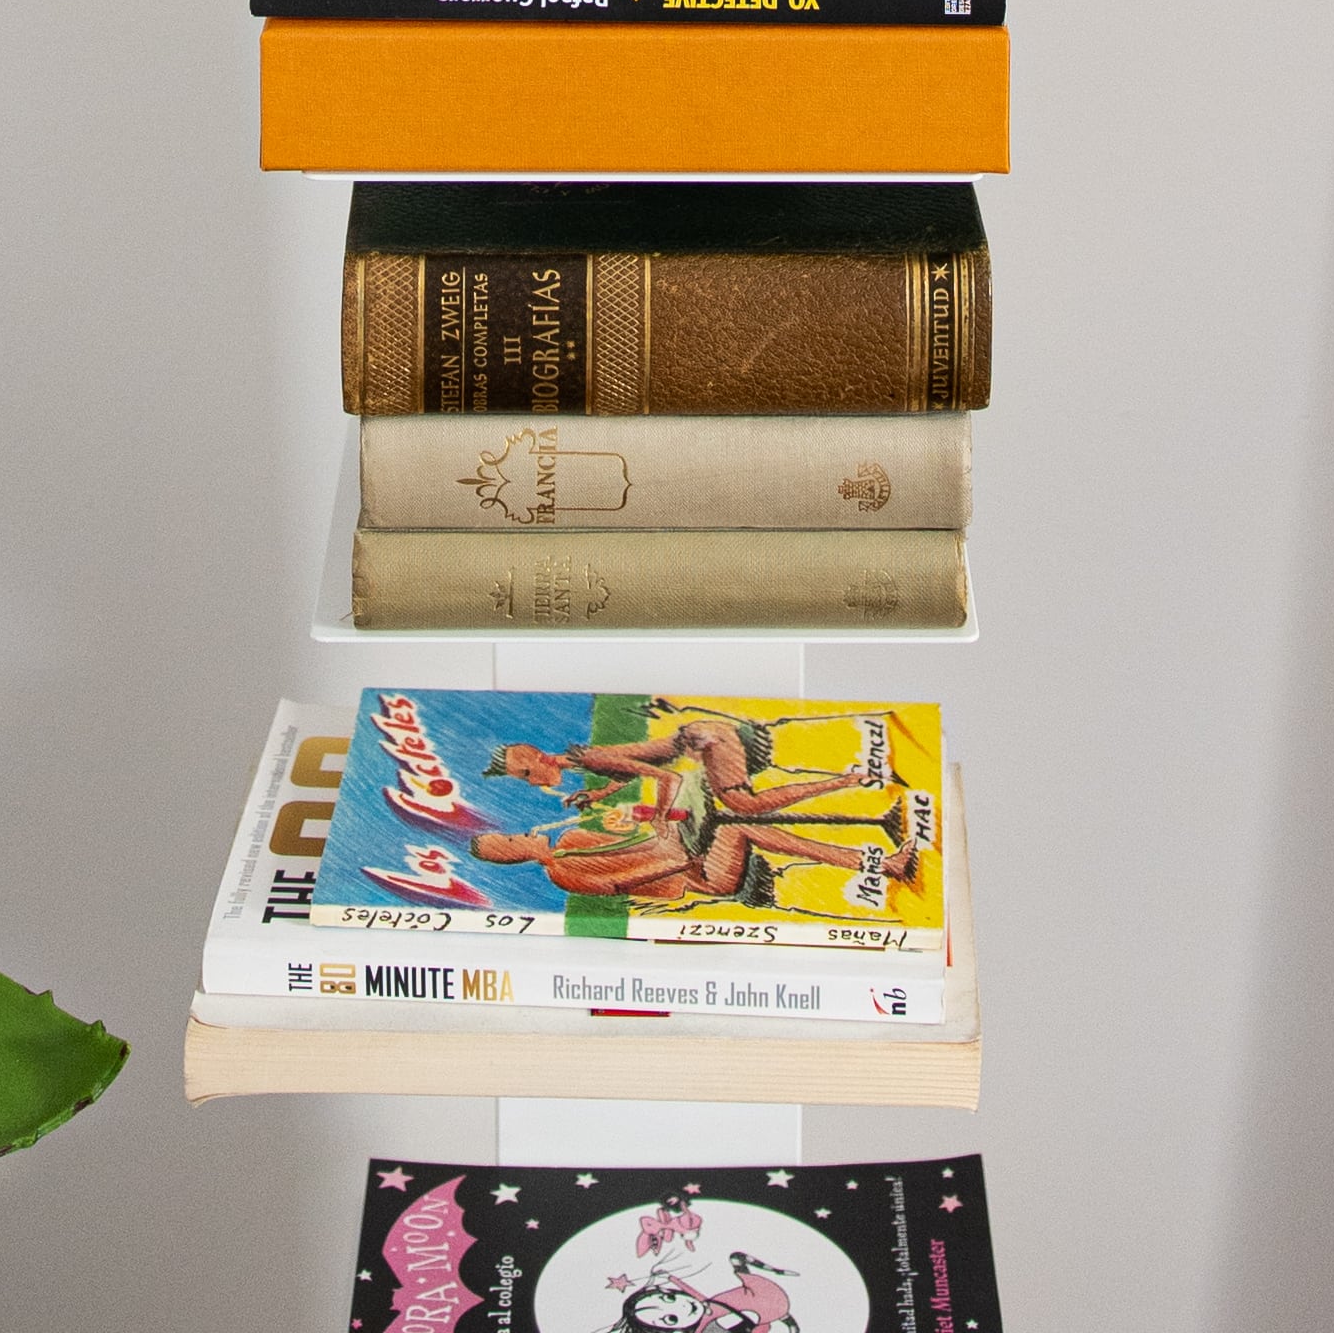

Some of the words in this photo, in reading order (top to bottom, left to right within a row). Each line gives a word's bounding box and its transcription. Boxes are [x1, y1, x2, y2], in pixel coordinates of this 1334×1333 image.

[441, 270, 460, 342] ZWEIG
[472, 272, 489, 368] COMPLETAS
[503, 336, 523, 365] III
[527, 268, 561, 413] BIOGRAFÍAS
[933, 286, 950, 399] JUVENTUD
[440, 354, 459, 413] STEFAN
[472, 374, 488, 413] OBRAS
[536, 425, 559, 524] FRANCIA
[234, 859, 257, 887] revised
[342, 907, 453, 932] Cócteles
[485, 912, 535, 934] Los
[680, 924, 779, 944] Szenczi
[828, 927, 907, 949] Mañas
[288, 962, 313, 992] THE
[366, 965, 455, 1000] MINUTE
[462, 968, 516, 1002] MBA
[553, 974, 625, 1002] Richard
[632, 978, 698, 1005] Reeves
[705, 980, 717, 1005] &
[724, 982, 767, 1008] John
[776, 984, 821, 1010] Knell
[489, 1256, 523, 1308] colegio
[929, 1239, 953, 1312] Muncaster
[489, 1311, 512, 1327] al
